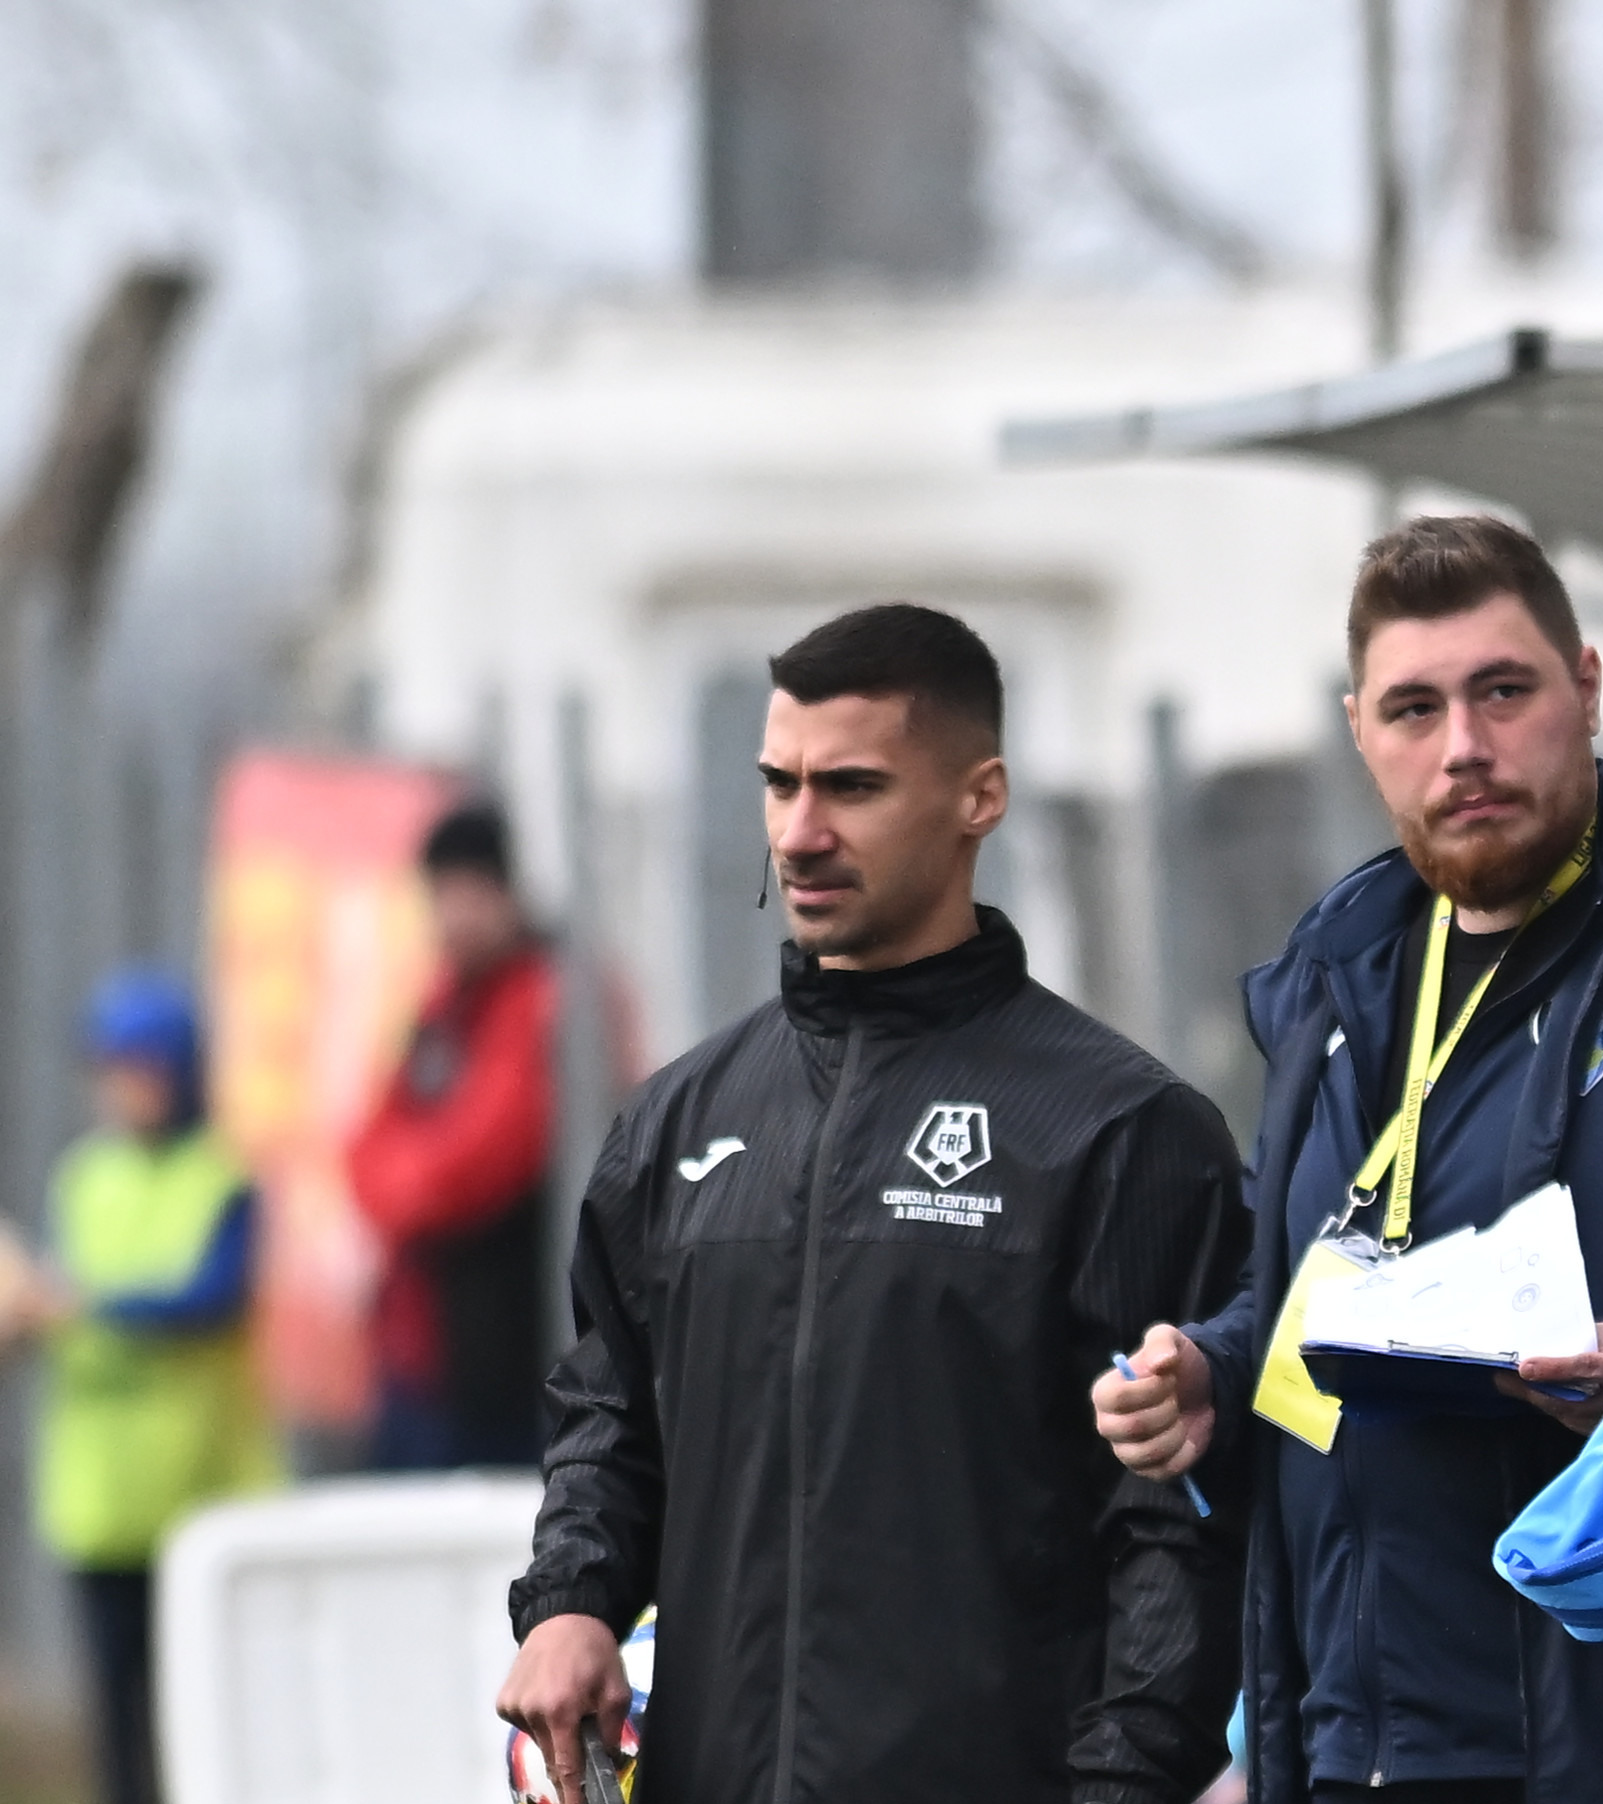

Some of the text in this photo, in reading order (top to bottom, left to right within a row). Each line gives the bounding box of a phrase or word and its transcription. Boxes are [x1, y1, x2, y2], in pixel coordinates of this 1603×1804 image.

[937, 1133, 967, 1153] FRF
[883, 1191, 932, 1205] COMISIA
[894, 1206, 984, 1227] A ARBITRILOR
